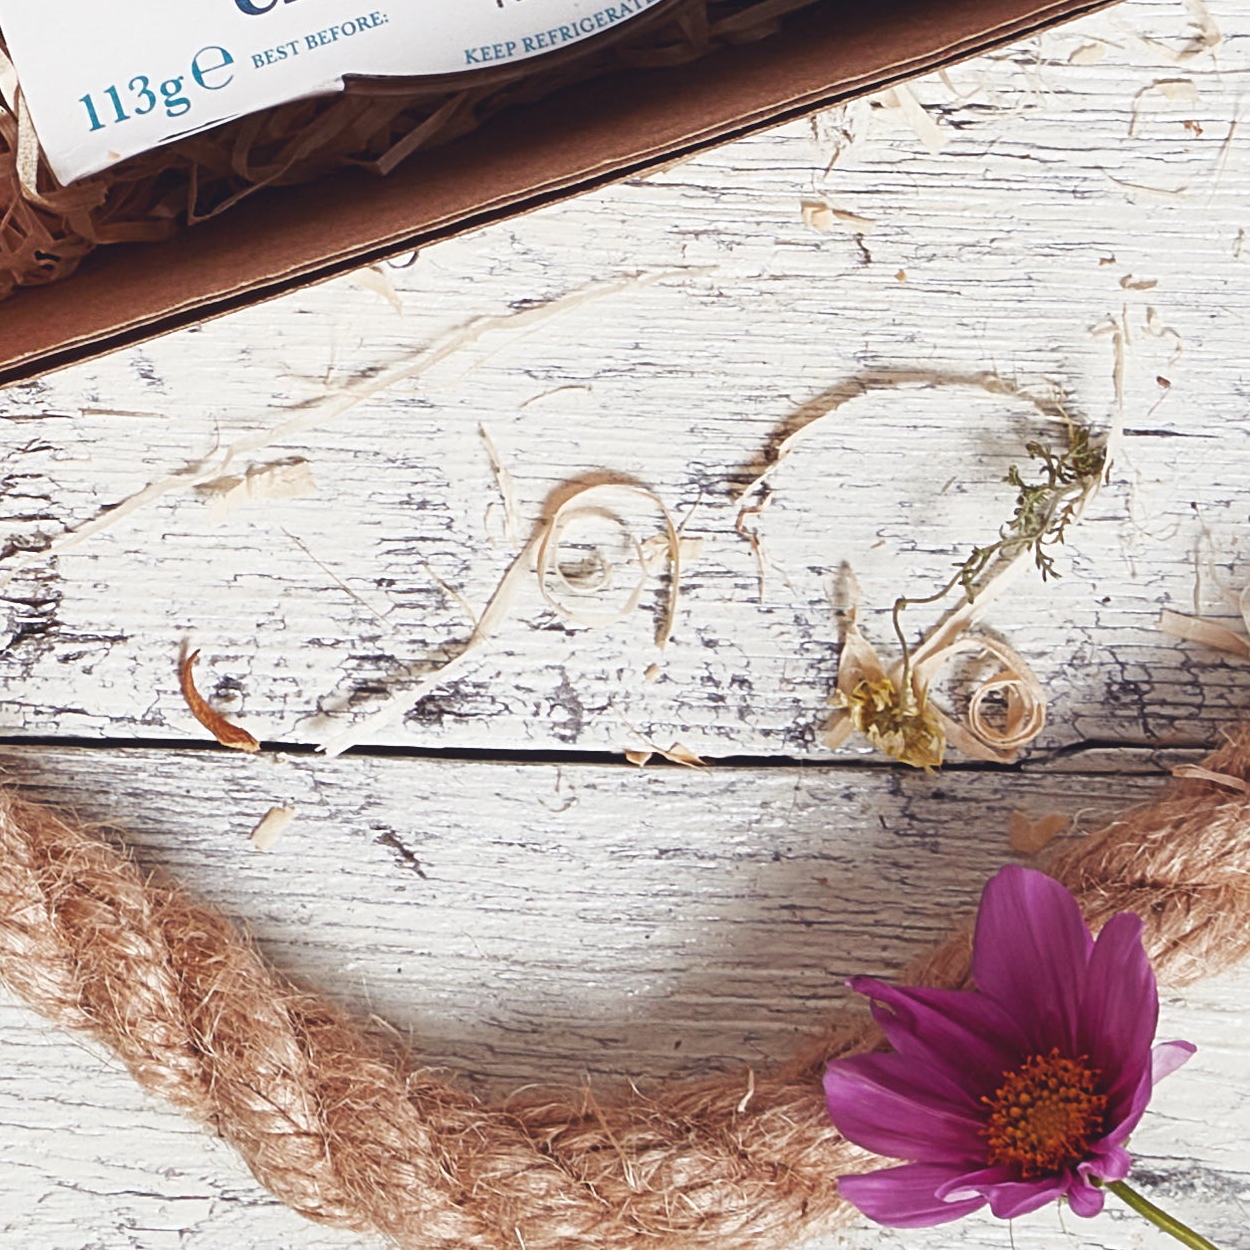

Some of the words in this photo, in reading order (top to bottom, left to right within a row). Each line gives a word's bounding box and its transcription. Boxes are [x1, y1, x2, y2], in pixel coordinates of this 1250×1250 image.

[251, 41, 300, 69] BEST
[305, 10, 390, 51] BEFORE:
[464, 42, 517, 65] KEEP
[78, 75, 191, 132] 113g
